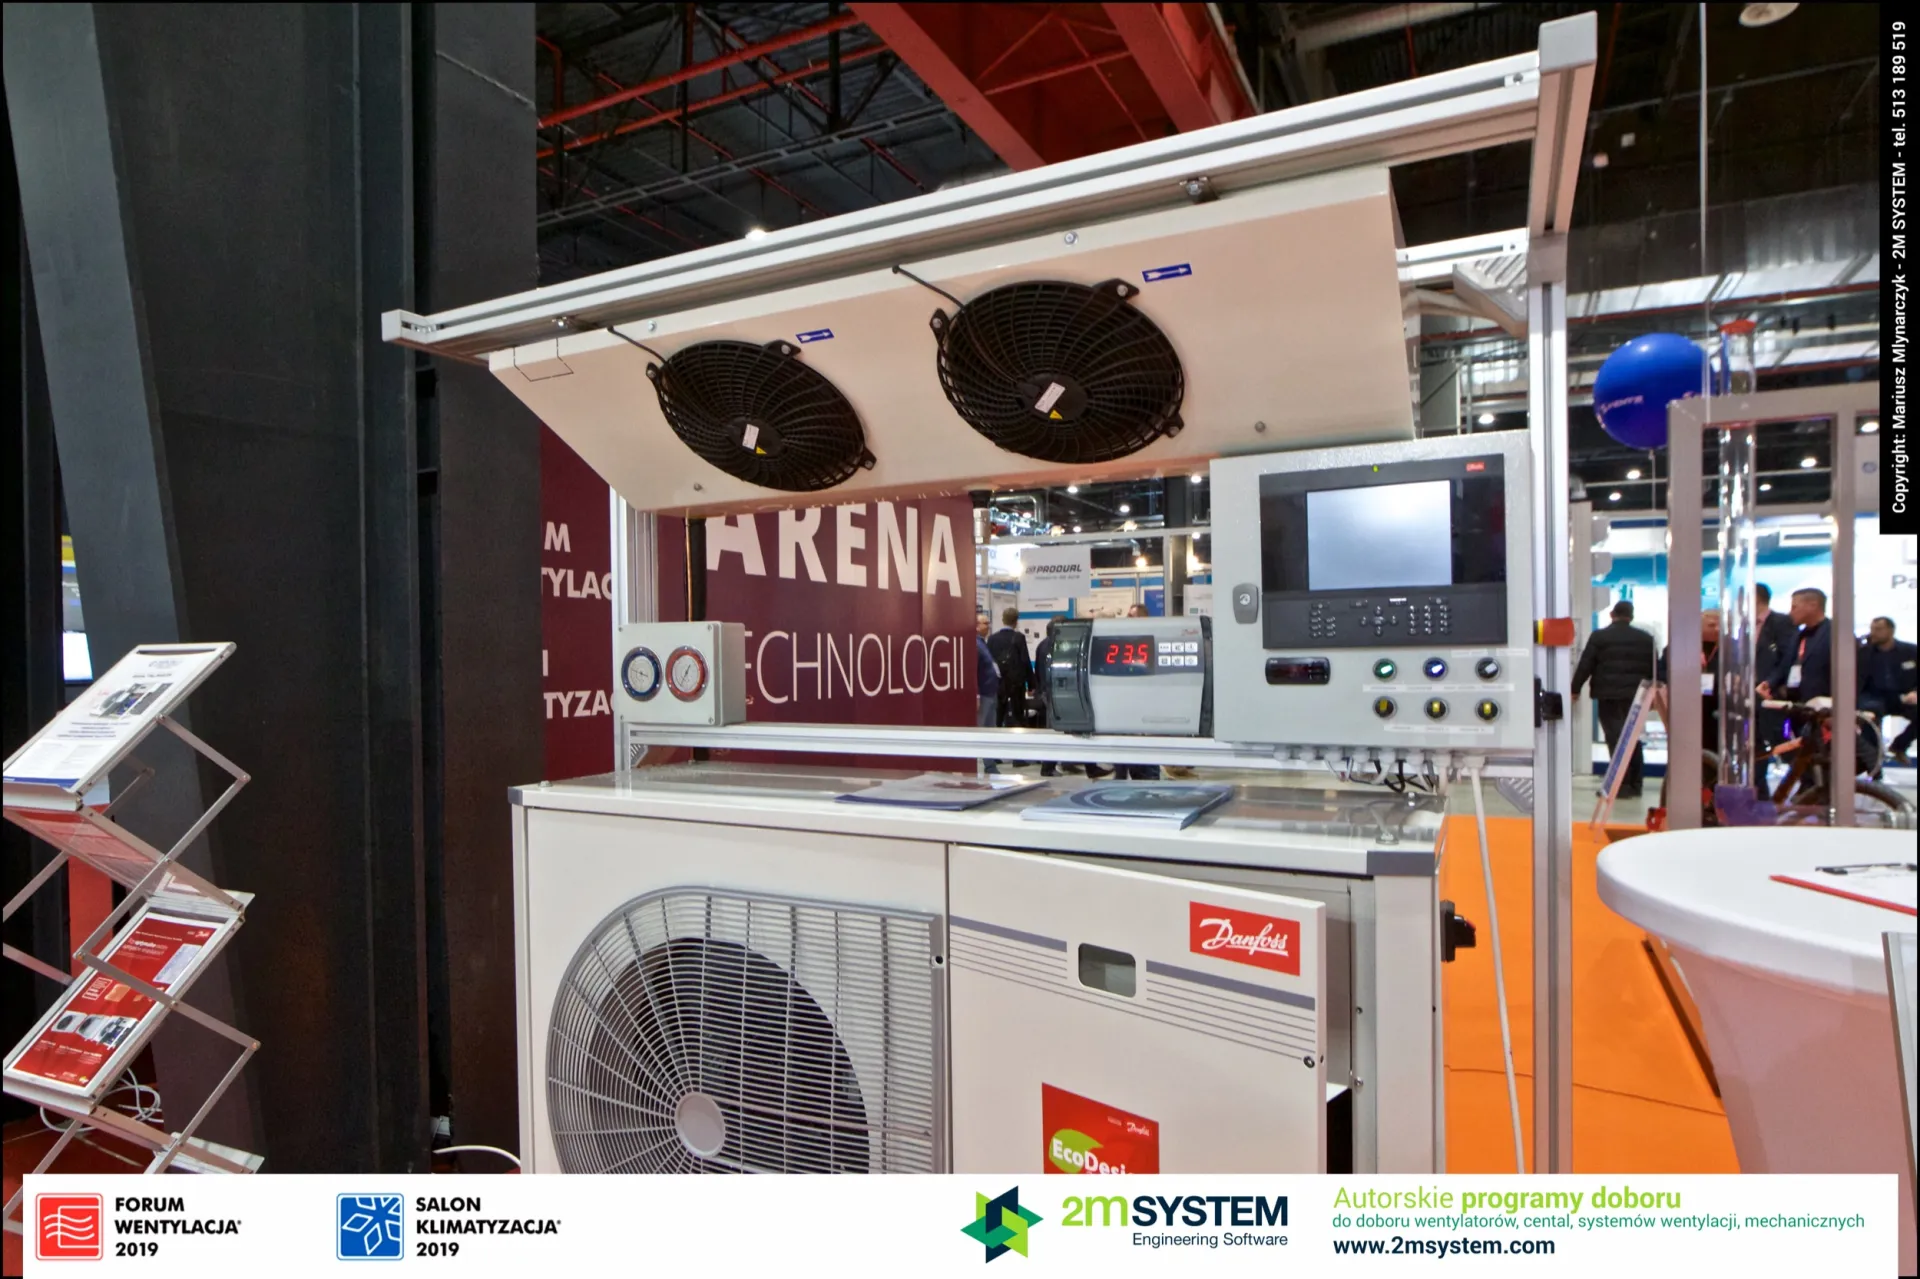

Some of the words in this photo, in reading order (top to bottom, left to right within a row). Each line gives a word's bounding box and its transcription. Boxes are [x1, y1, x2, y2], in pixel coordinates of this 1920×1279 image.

[706, 502, 962, 598] ARENA
[1036, 563, 1082, 574] PRODUAL
[543, 689, 614, 719] TYZA
[1199, 917, 1289, 957] Danfoss
[1052, 1137, 1134, 1174] EcoDesi
